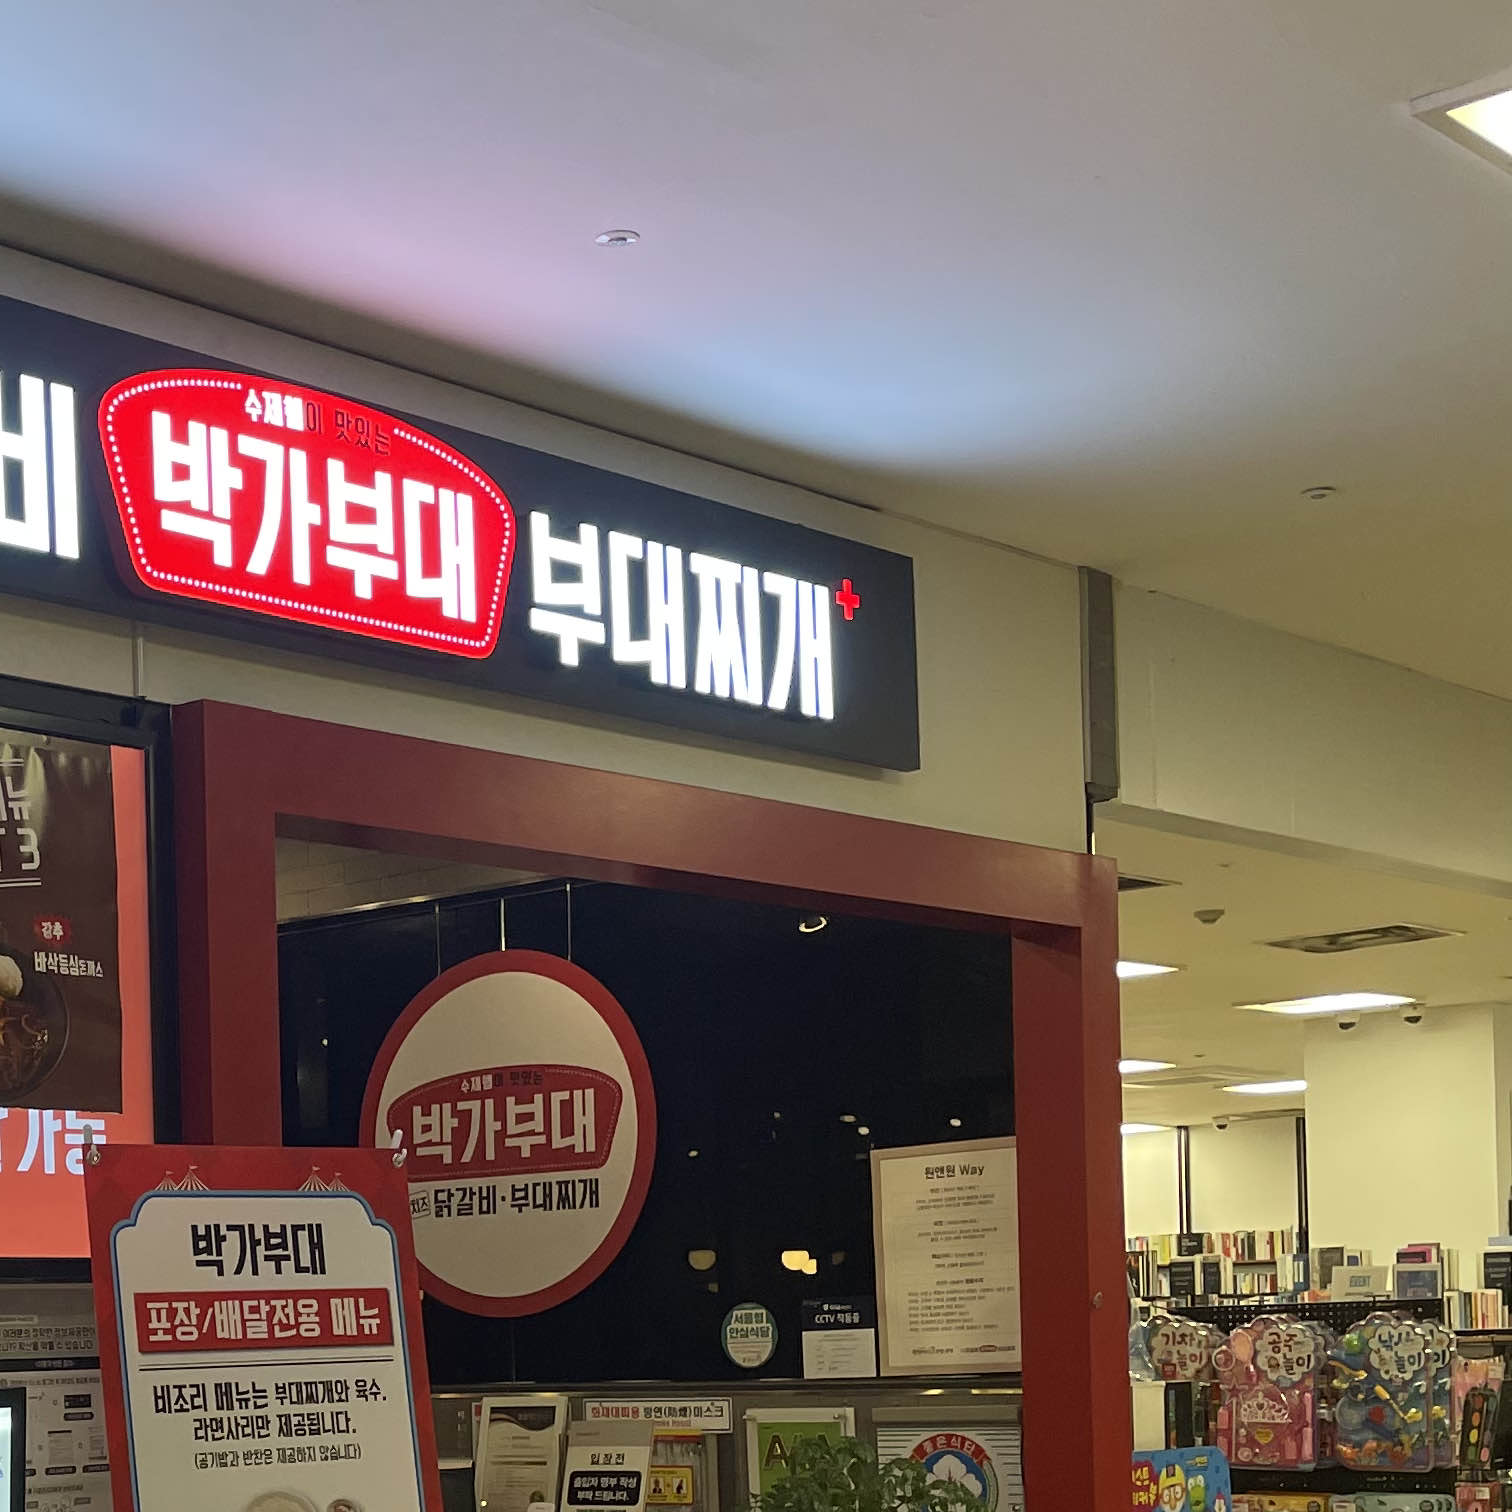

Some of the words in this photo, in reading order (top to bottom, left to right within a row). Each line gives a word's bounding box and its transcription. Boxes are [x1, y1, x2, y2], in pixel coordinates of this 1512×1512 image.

[150, 409, 478, 623] 박가부대
[529, 510, 836, 720] 부대찌개
[16, 827, 41, 871] 3
[411, 1087, 597, 1165] 박가부대
[959, 1163, 985, 1176] Way
[410, 1195, 430, 1216] 치즈
[190, 1223, 327, 1277] 박가부대
[145, 1298, 321, 1343] 포장/배달전용
[330, 1297, 381, 1337] 메뉴
[728, 1325, 771, 1340] 안심식당
[815, 1314, 835, 1324] CCTV
[1268, 1331, 1298, 1355] 공주
[152, 1383, 209, 1415] 비조리
[214, 1381, 269, 1412] 메뉴는
[274, 1380, 350, 1408] 부대찌개와
[193, 1414, 272, 1442] 라면사리만
[277, 1410, 357, 1440] 제공됩니다.
[194, 1448, 239, 1471] (공기밥과
[242, 1447, 274, 1467] 반찬은
[276, 1445, 317, 1465] 제공하지
[319, 1443, 362, 1463] 않습니다)
